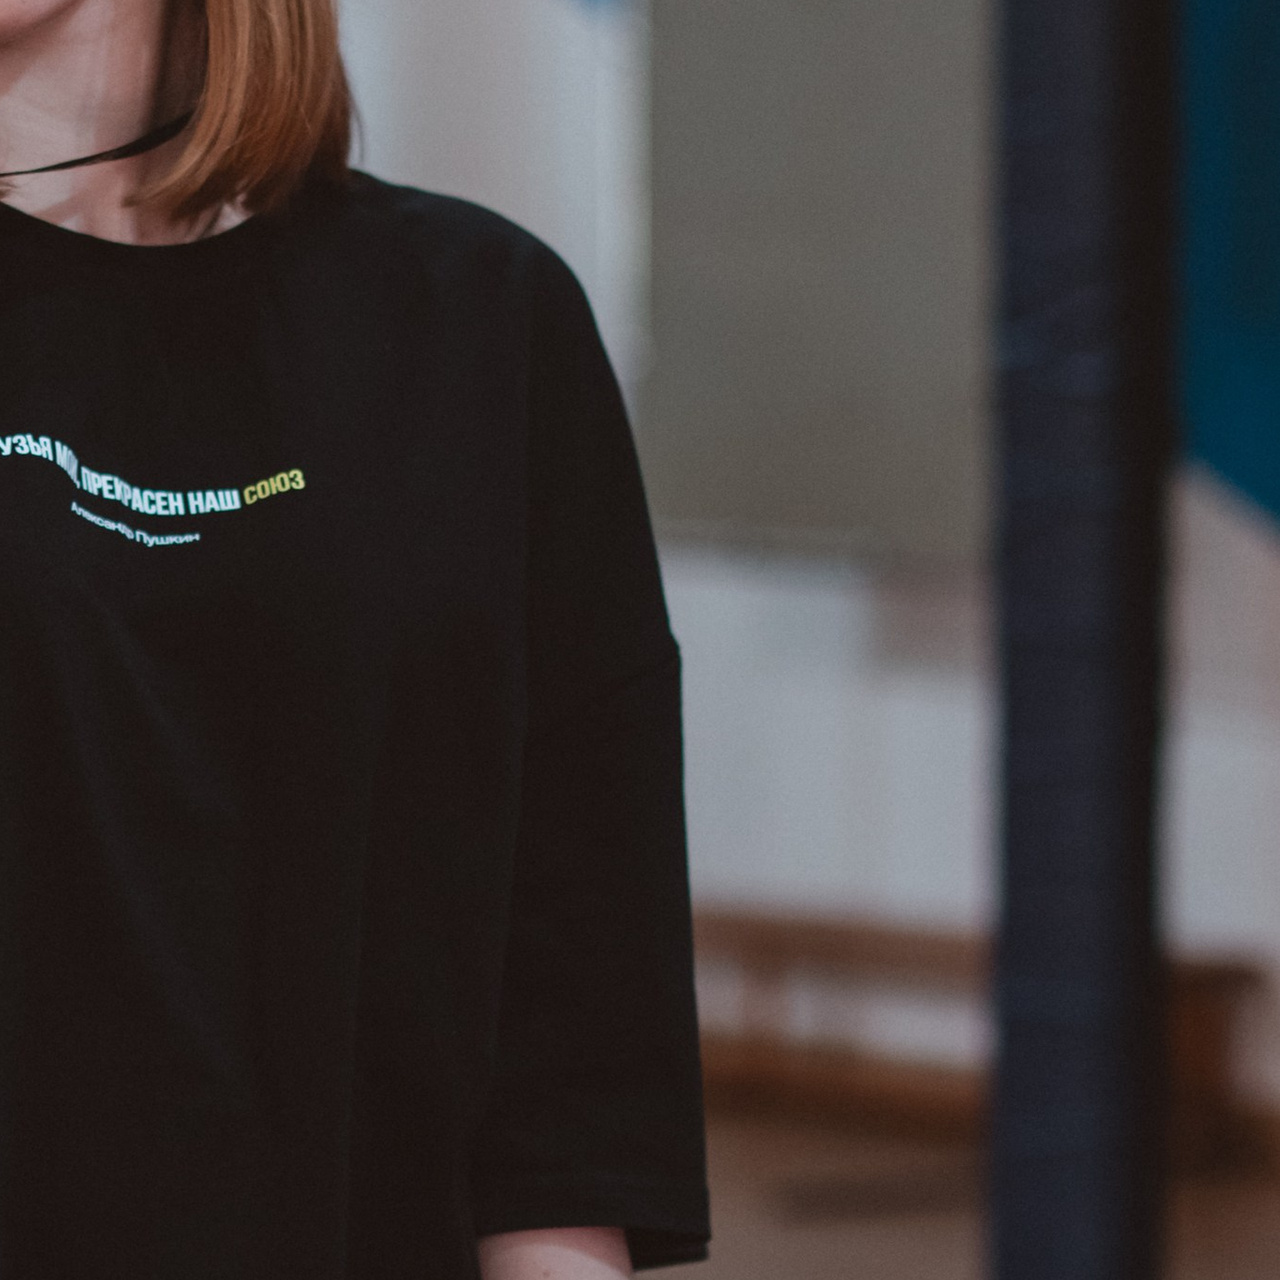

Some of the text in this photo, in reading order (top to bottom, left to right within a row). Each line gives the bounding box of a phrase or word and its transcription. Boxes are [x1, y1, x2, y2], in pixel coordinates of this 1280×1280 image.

[80, 465, 185, 516] ПРЕКРАСЕН
[187, 489, 242, 515] НАШ
[243, 469, 306, 505] СОЮЗ
[135, 529, 201, 548] Пушкин
